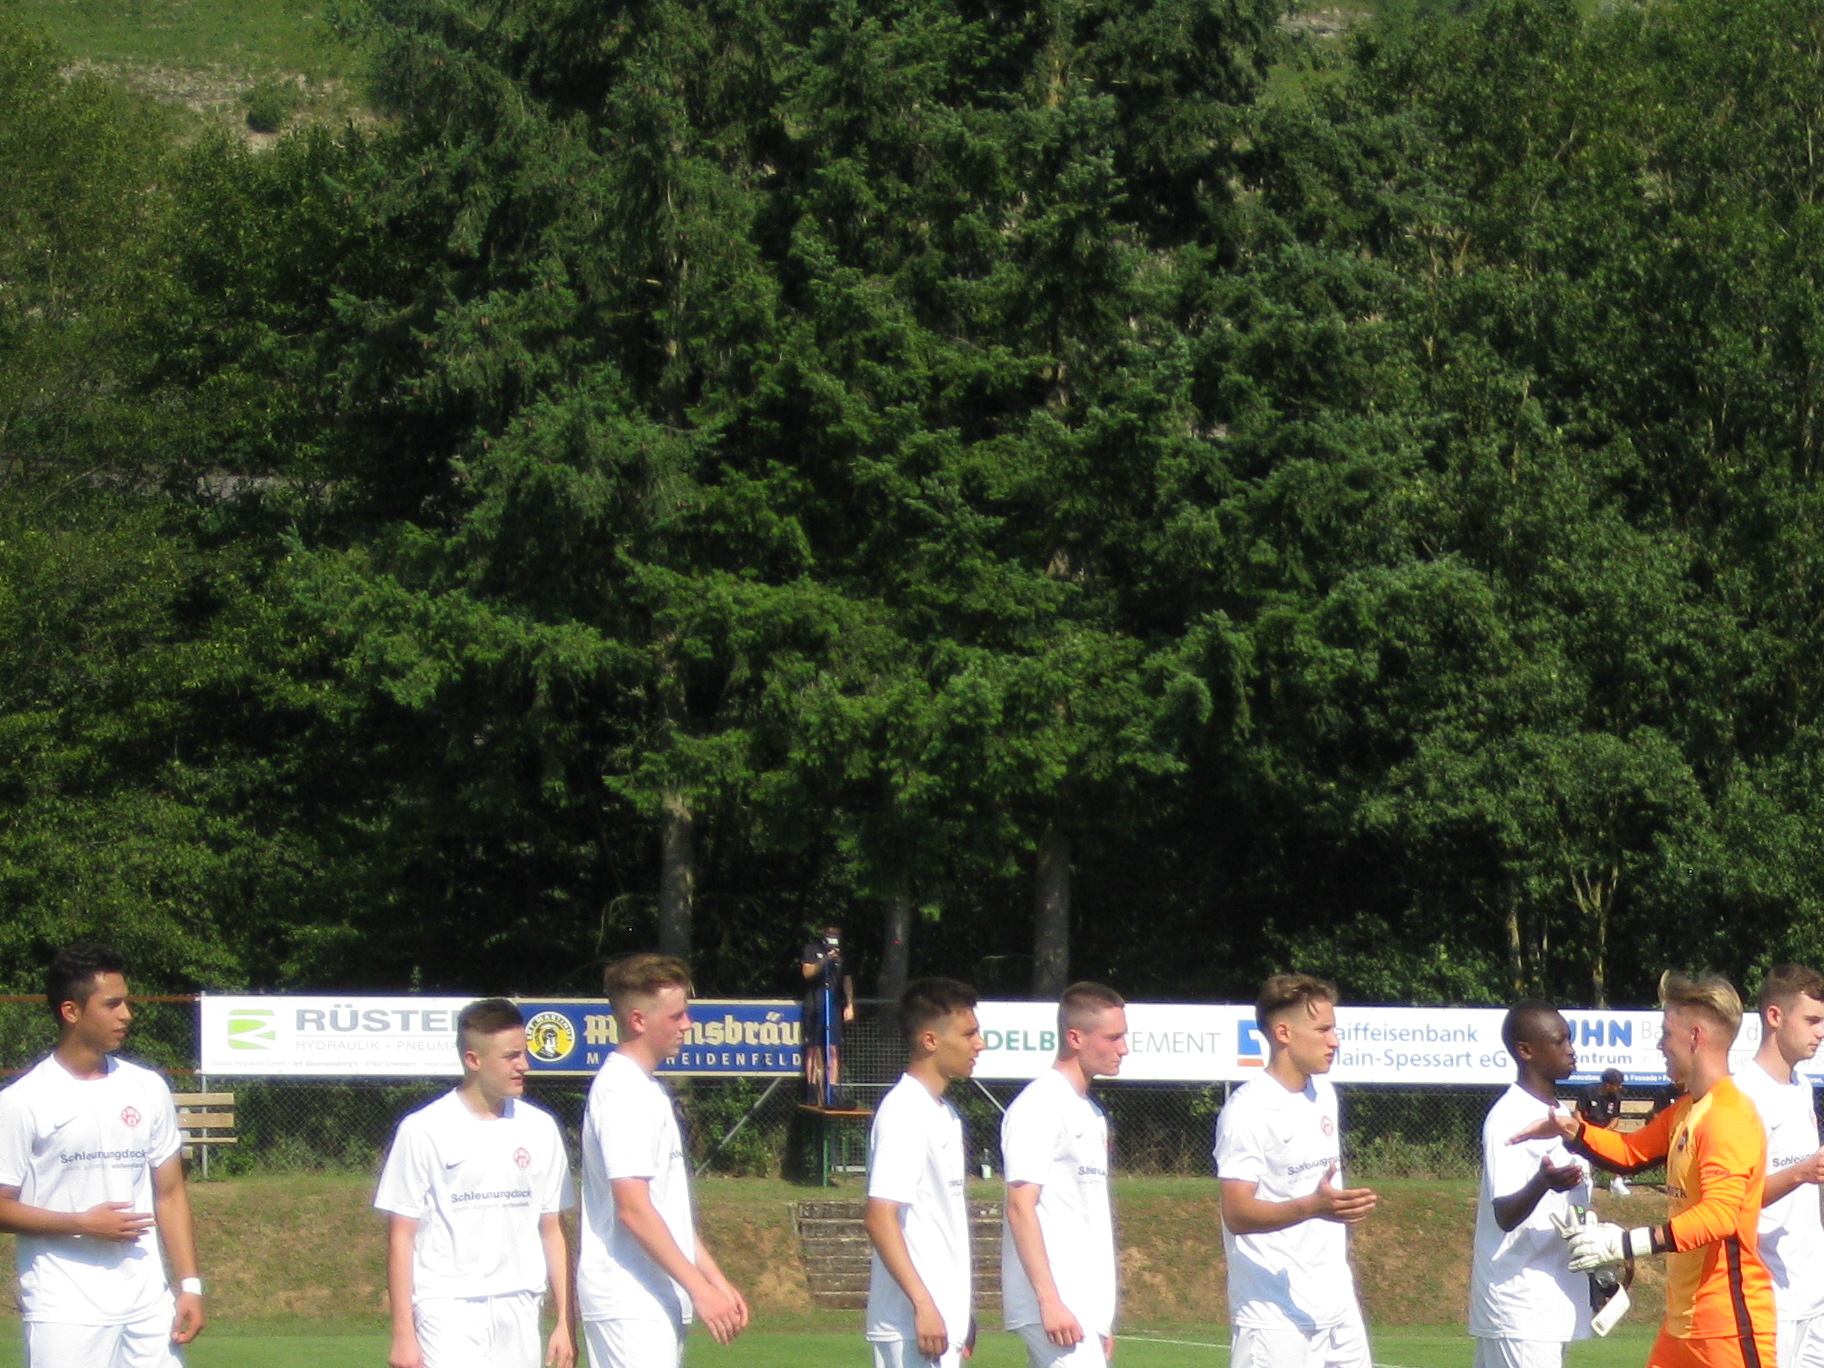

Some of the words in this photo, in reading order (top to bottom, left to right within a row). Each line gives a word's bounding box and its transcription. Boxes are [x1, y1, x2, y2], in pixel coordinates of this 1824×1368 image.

[1336, 1022, 1479, 1043] aiffeisenbank
[296, 1040, 379, 1051] HYDRAULIK
[396, 1040, 458, 1052] PNEUMA
[1479, 1050, 1508, 1068] eG
